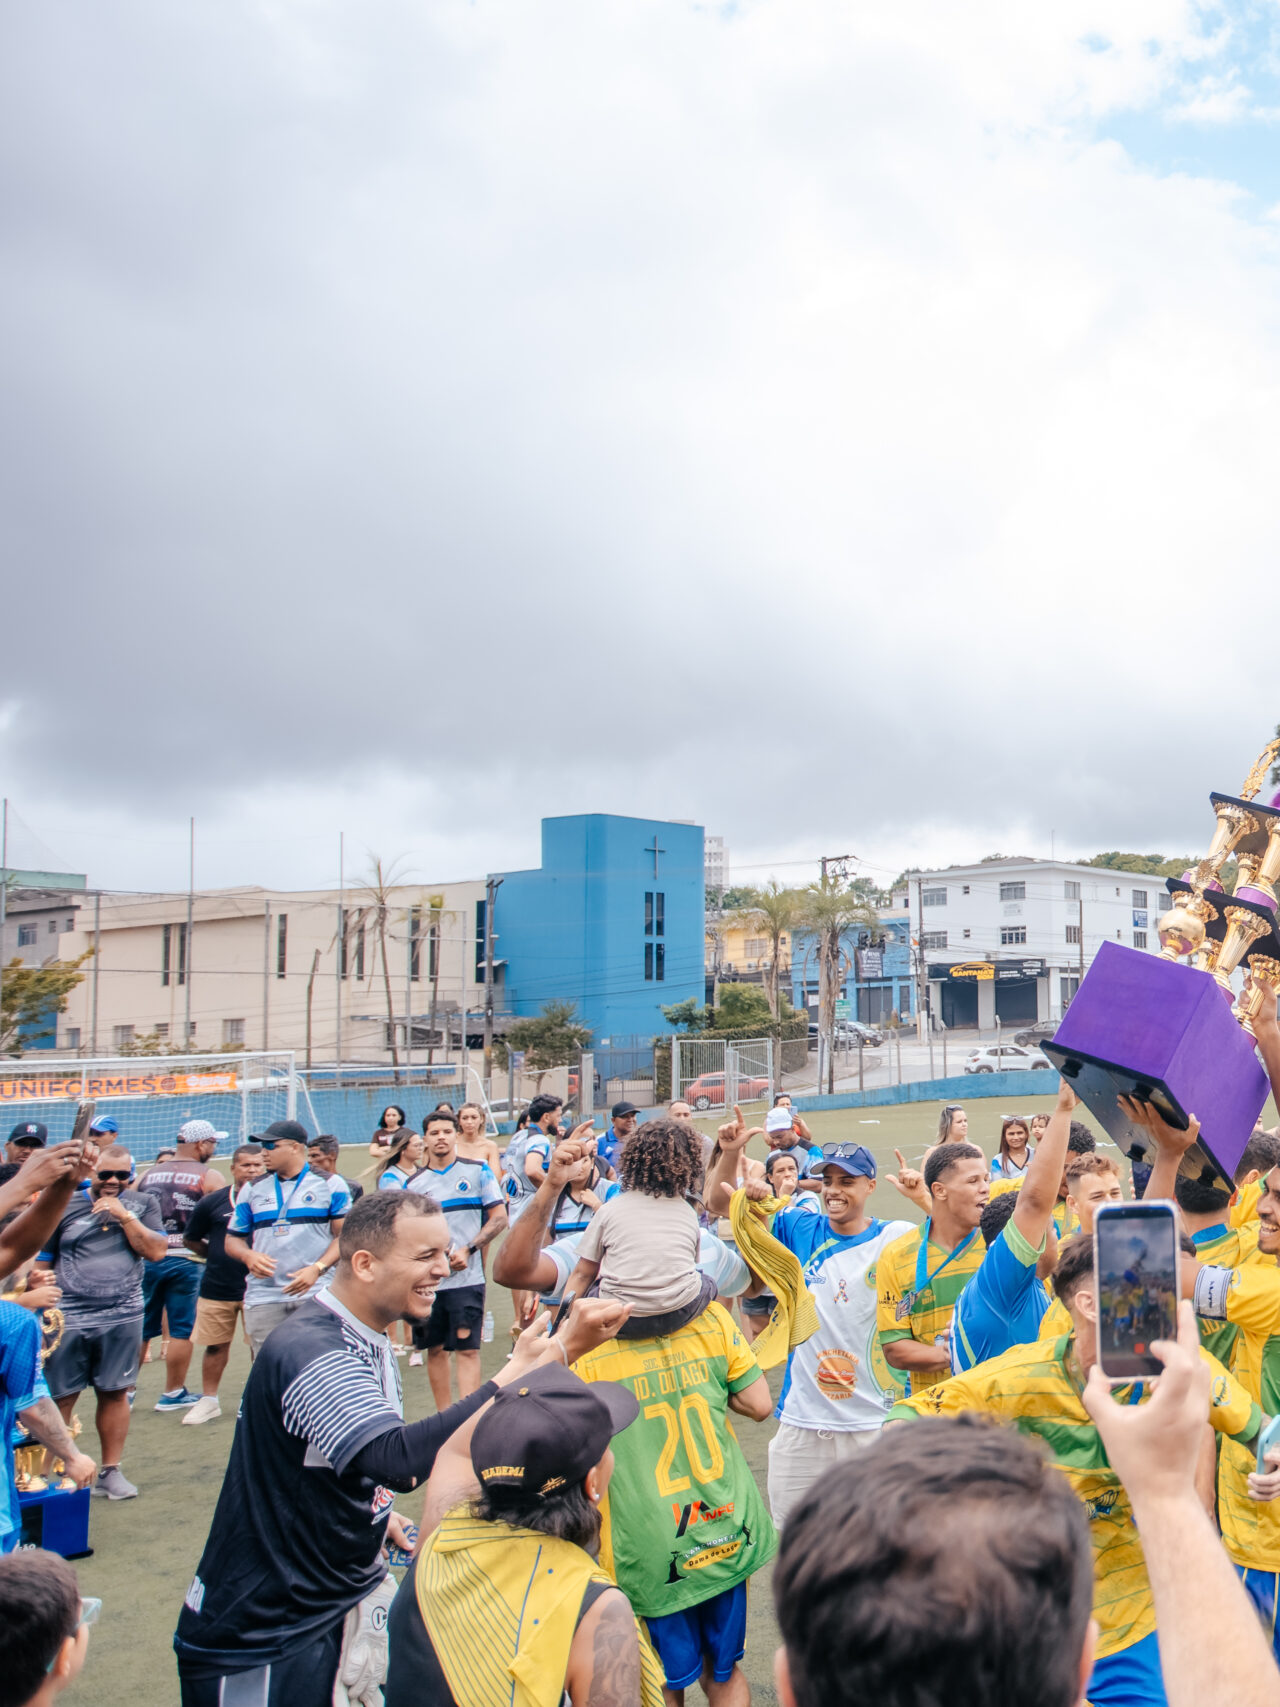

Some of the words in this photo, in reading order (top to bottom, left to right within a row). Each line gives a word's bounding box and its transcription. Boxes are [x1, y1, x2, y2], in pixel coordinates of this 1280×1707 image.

[0, 1077, 157, 1099] UNIFORMES
[679, 1360, 710, 1390] AGO
[643, 1391, 725, 1498] 20
[688, 1554, 709, 1567] Dama
